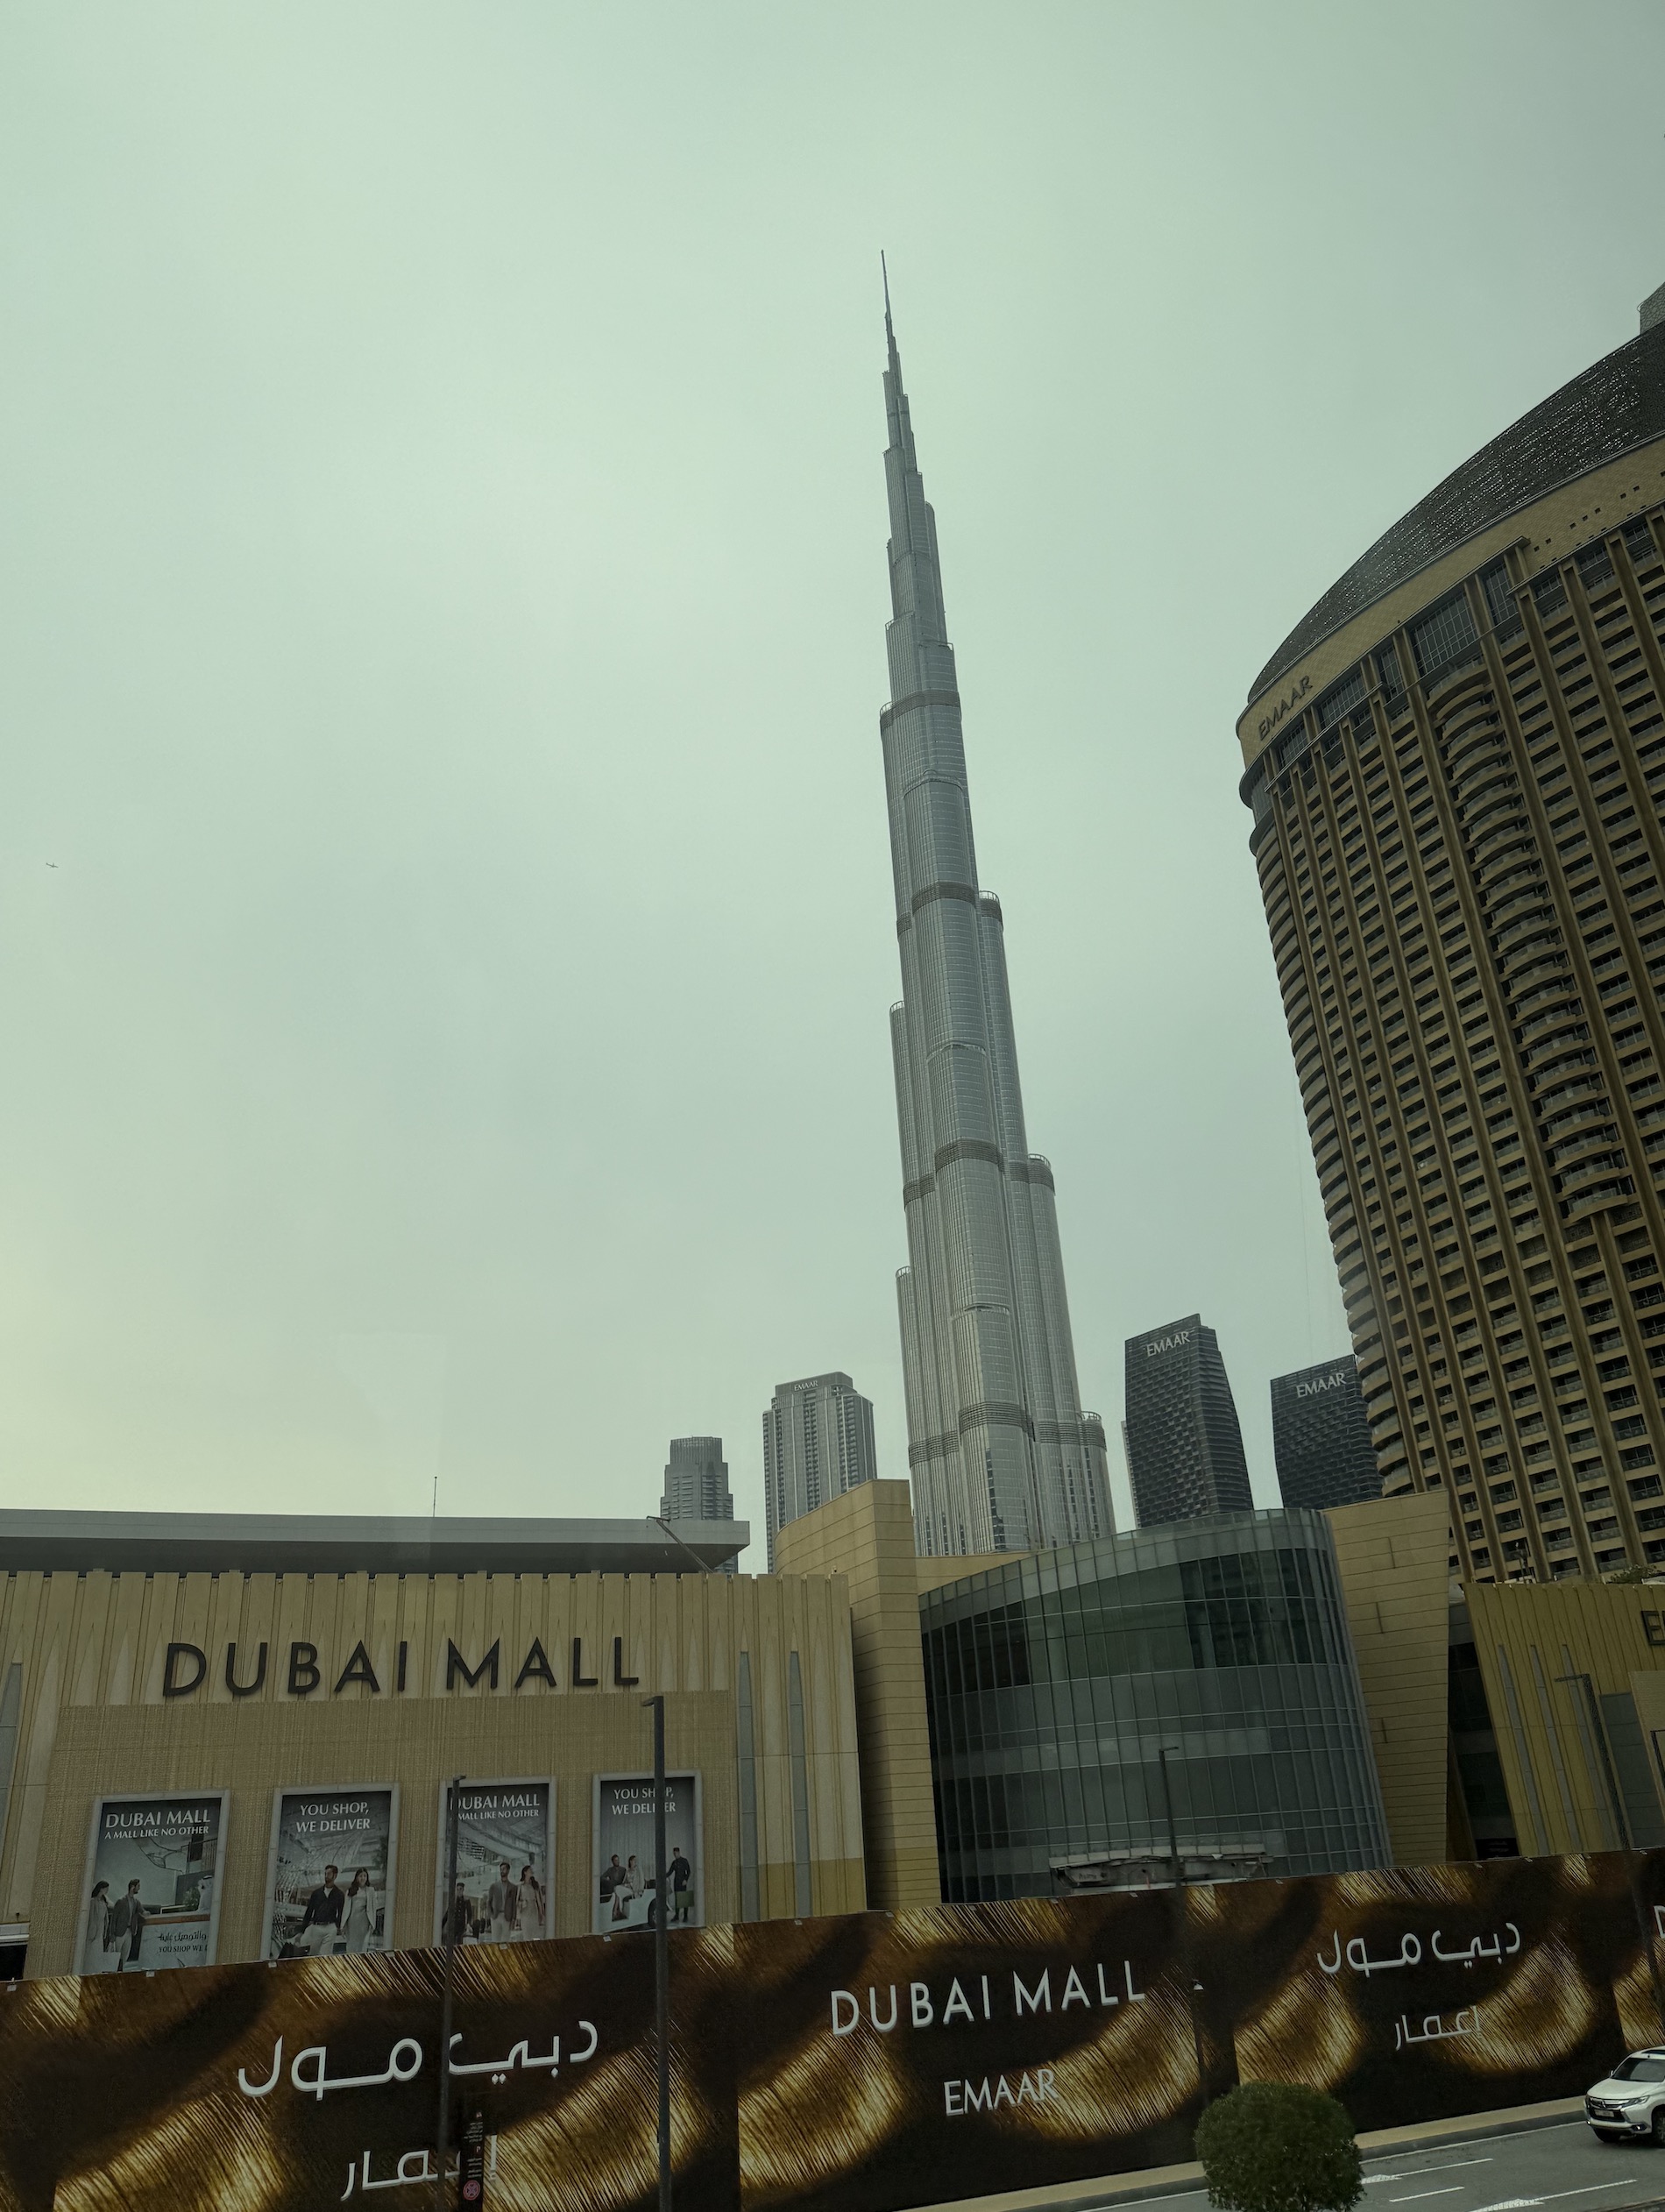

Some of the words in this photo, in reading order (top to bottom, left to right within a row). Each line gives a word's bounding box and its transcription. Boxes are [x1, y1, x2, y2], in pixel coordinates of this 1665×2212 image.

[1258, 675, 1313, 741] EMAAR
[1146, 1331, 1191, 1358] EMAAR
[794, 1379, 818, 1392] EMAAR
[1295, 1372, 1347, 1399] EMAAR
[162, 1640, 407, 1697] DUBAI
[446, 1636, 639, 1690] MALL
[502, 1793, 541, 1808] MALL
[613, 1788, 639, 1800] YOU
[641, 1786, 674, 1798] SHP,
[105, 1811, 162, 1828] DUBAI
[166, 1809, 211, 1825] MALL
[300, 1804, 329, 1816] YOU
[332, 1801, 370, 1815] SHOP,
[480, 1811, 497, 1819] LIKE
[498, 1810, 511, 1819] NO
[513, 1809, 540, 1818] OTHER
[611, 1804, 630, 1815] WE
[632, 1801, 677, 1814] DELIER
[104, 1831, 111, 1840] A
[113, 1830, 138, 1839] MALL
[139, 1828, 159, 1838] LIKE
[161, 1827, 177, 1837] NO
[178, 1826, 209, 1836] OTHER
[296, 1820, 316, 1833] WE
[320, 1818, 371, 1832] DELIVER
[1316, 1928, 1423, 1978] مول
[1430, 1921, 1521, 1969] دبي
[830, 1974, 991, 2037] DUBAI
[1012, 1960, 1146, 2017] MALL
[1394, 2004, 1483, 2052] إعمار
[448, 2018, 599, 2086] دبي
[237, 2034, 425, 2102] مول
[943, 2068, 1060, 2116] EMAAR
[339, 2133, 499, 2202] إمار
